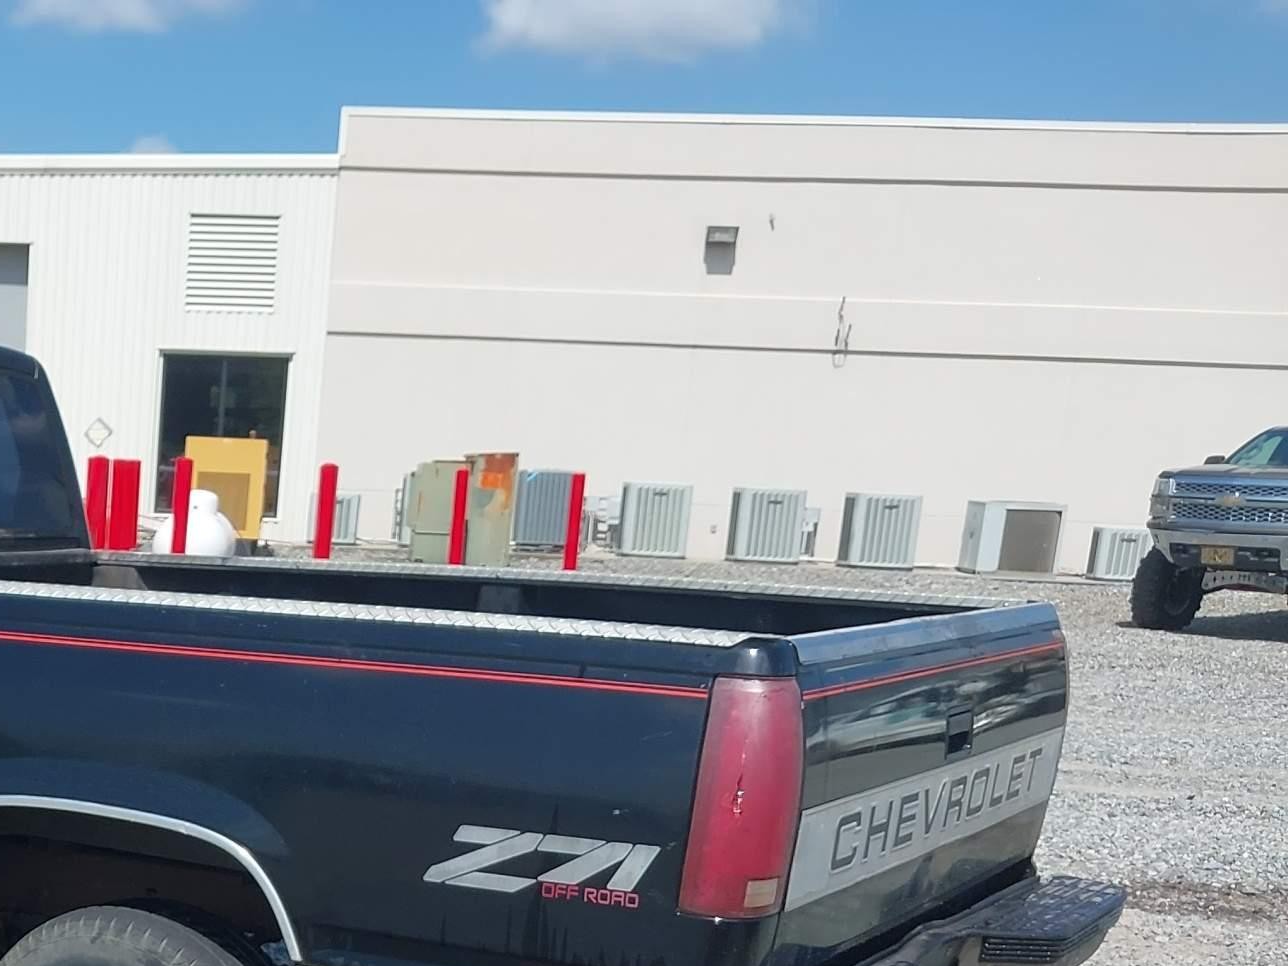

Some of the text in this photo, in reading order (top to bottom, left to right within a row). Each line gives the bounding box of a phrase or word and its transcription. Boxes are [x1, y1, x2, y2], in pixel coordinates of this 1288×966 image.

[829, 747, 1043, 873] CHEVROLET
[422, 824, 662, 893] Z71
[541, 883, 640, 909] OFF ROAD
